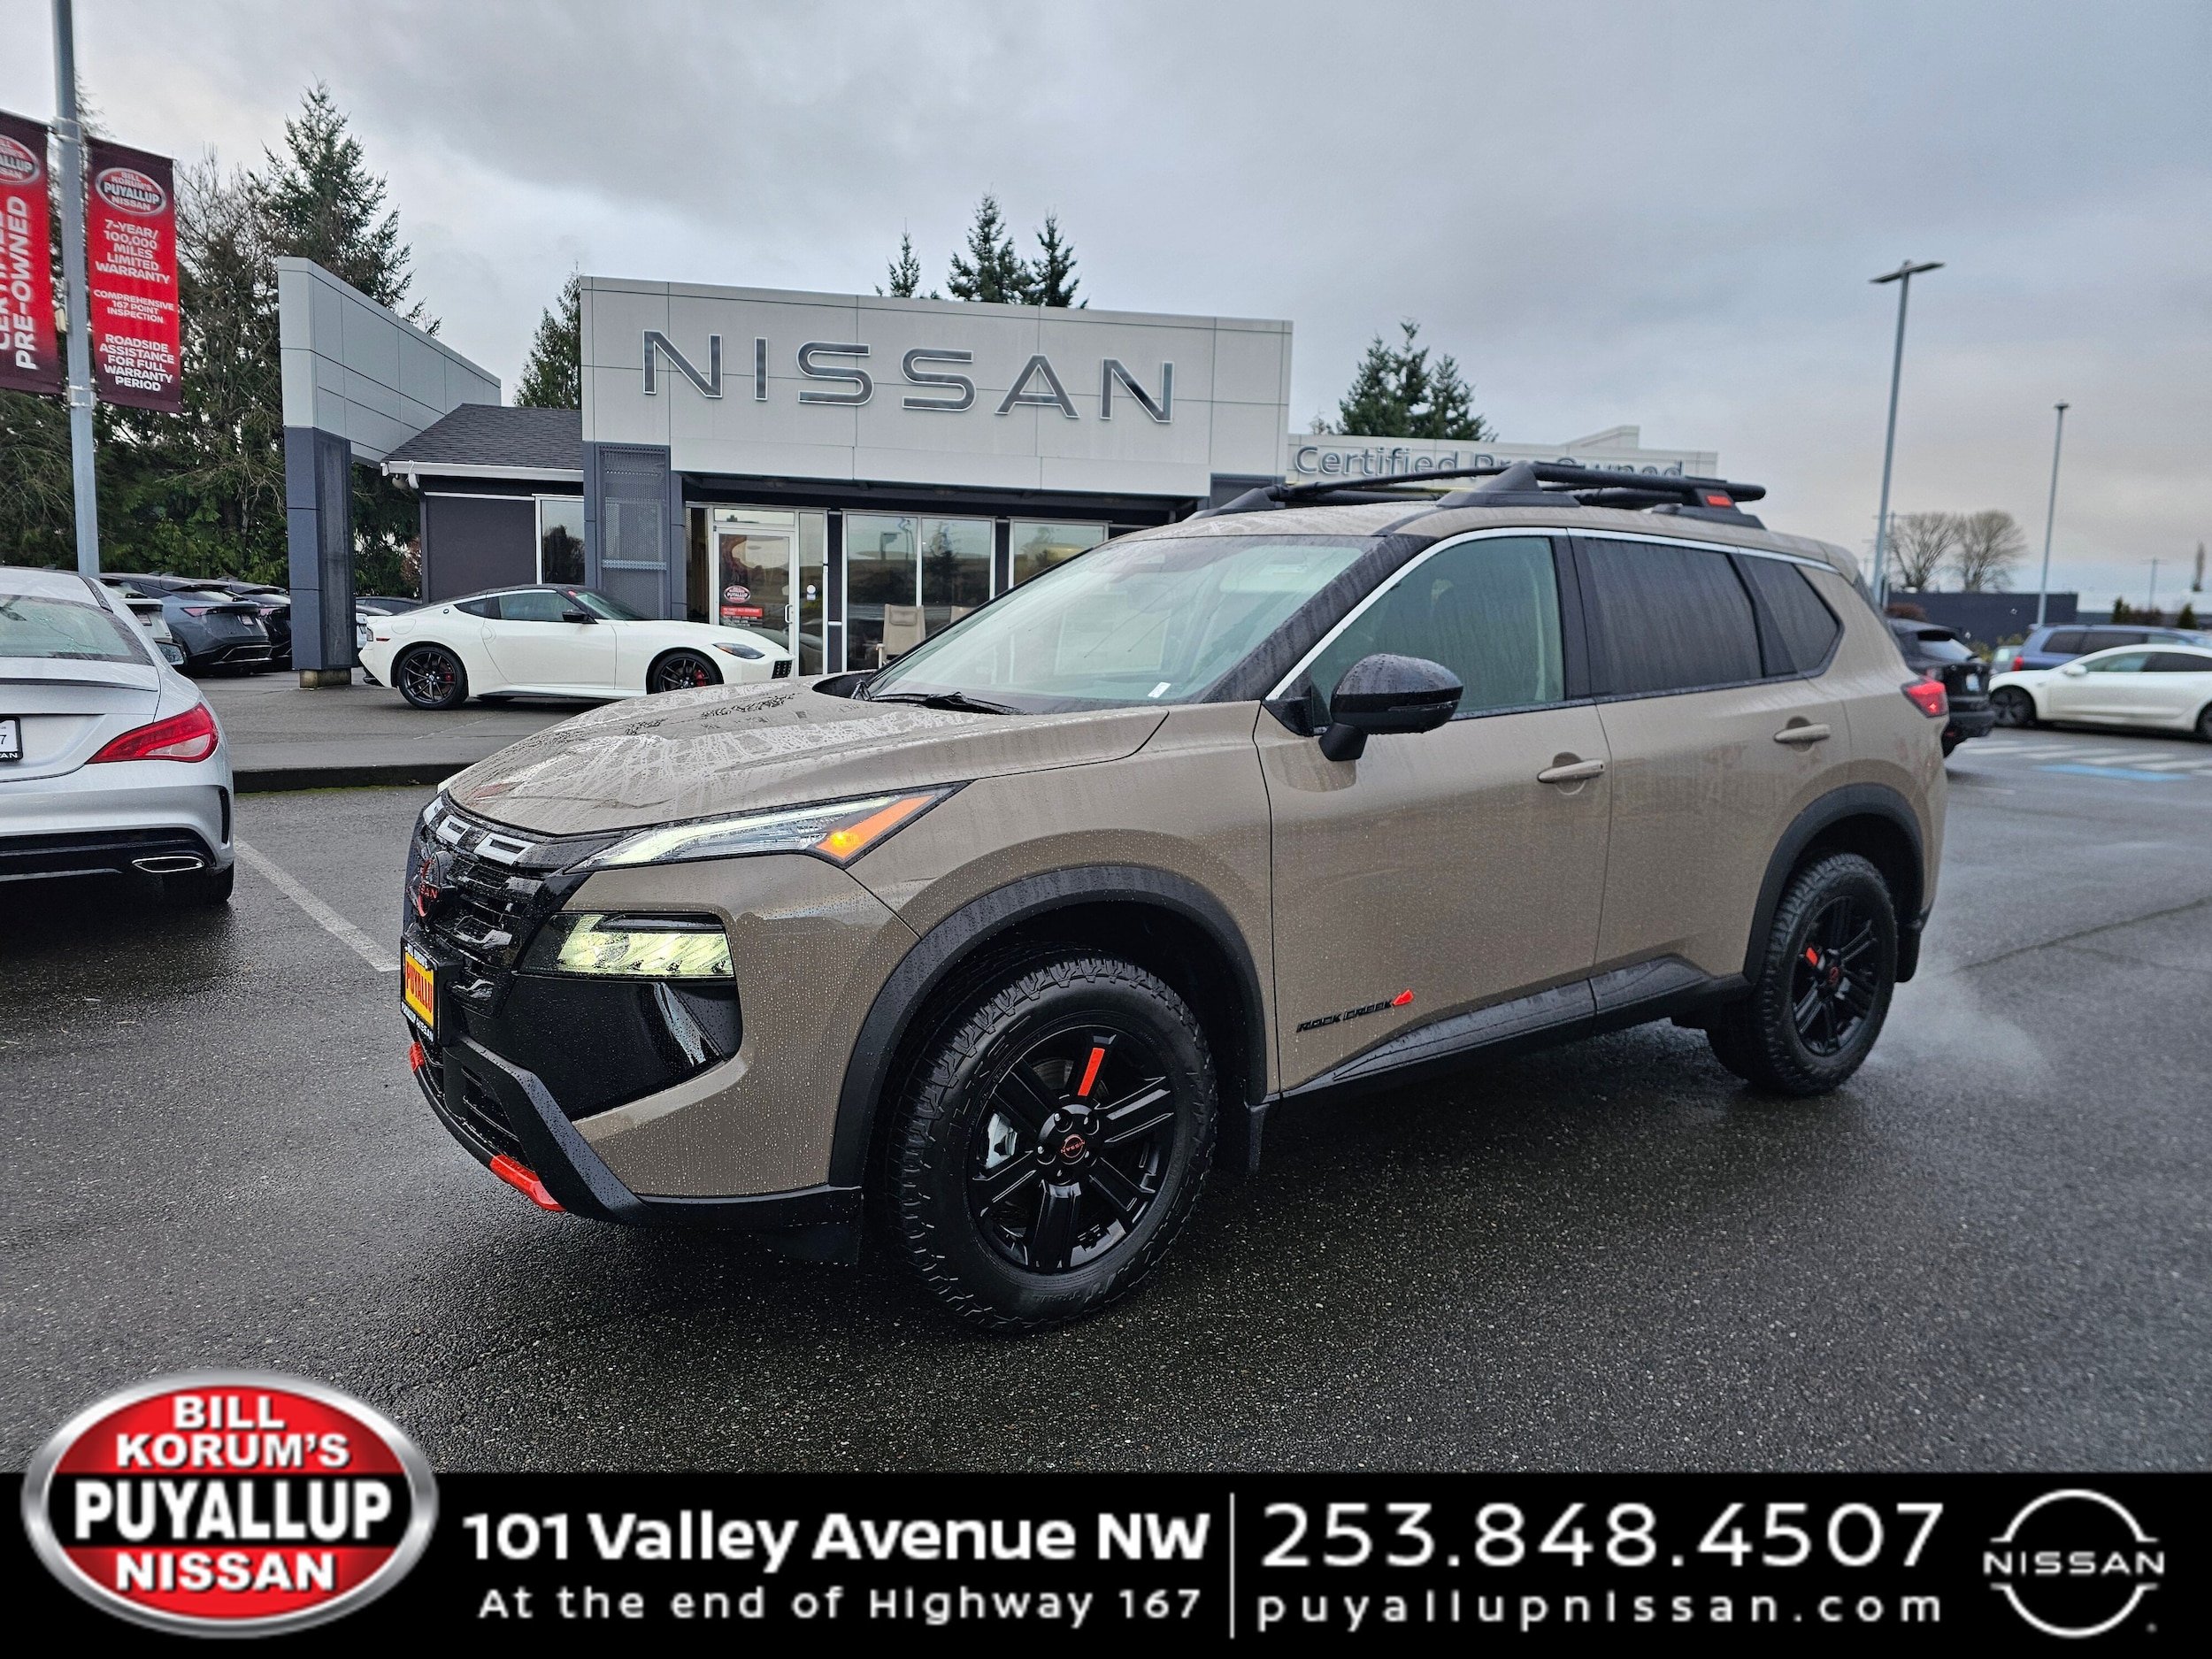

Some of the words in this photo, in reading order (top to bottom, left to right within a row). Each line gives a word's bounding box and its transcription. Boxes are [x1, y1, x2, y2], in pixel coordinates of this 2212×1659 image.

[111, 175, 152, 191] KORUM'S
[121, 171, 141, 182] BILL
[104, 181, 159, 204] PUYALLUP
[111, 196, 150, 211] NISSAN
[105, 219, 158, 240] 7-YEAR/
[113, 242, 154, 259] MILES
[107, 252, 159, 272] LIMITED
[95, 260, 170, 284] WARRANTY
[7, 196, 38, 370] PRE-OWNED
[93, 289, 174, 311] COMPREHENSIVE
[111, 300, 129, 309] 167
[130, 303, 159, 314] POINT
[107, 307, 164, 324] INSPECTION
[105, 334, 168, 353] ROADSIDE
[99, 343, 174, 365] ASSISTANCE
[108, 354, 135, 367] FOR
[137, 359, 166, 373] FULL
[104, 364, 173, 383] WARRANTY
[641, 329, 1175, 424] NISSAN
[115, 375, 161, 392] PERIOD
[1295, 445, 1460, 477] Certified
[1296, 1012, 1343, 1033] ROCK
[1343, 999, 1393, 1022] CREEK
